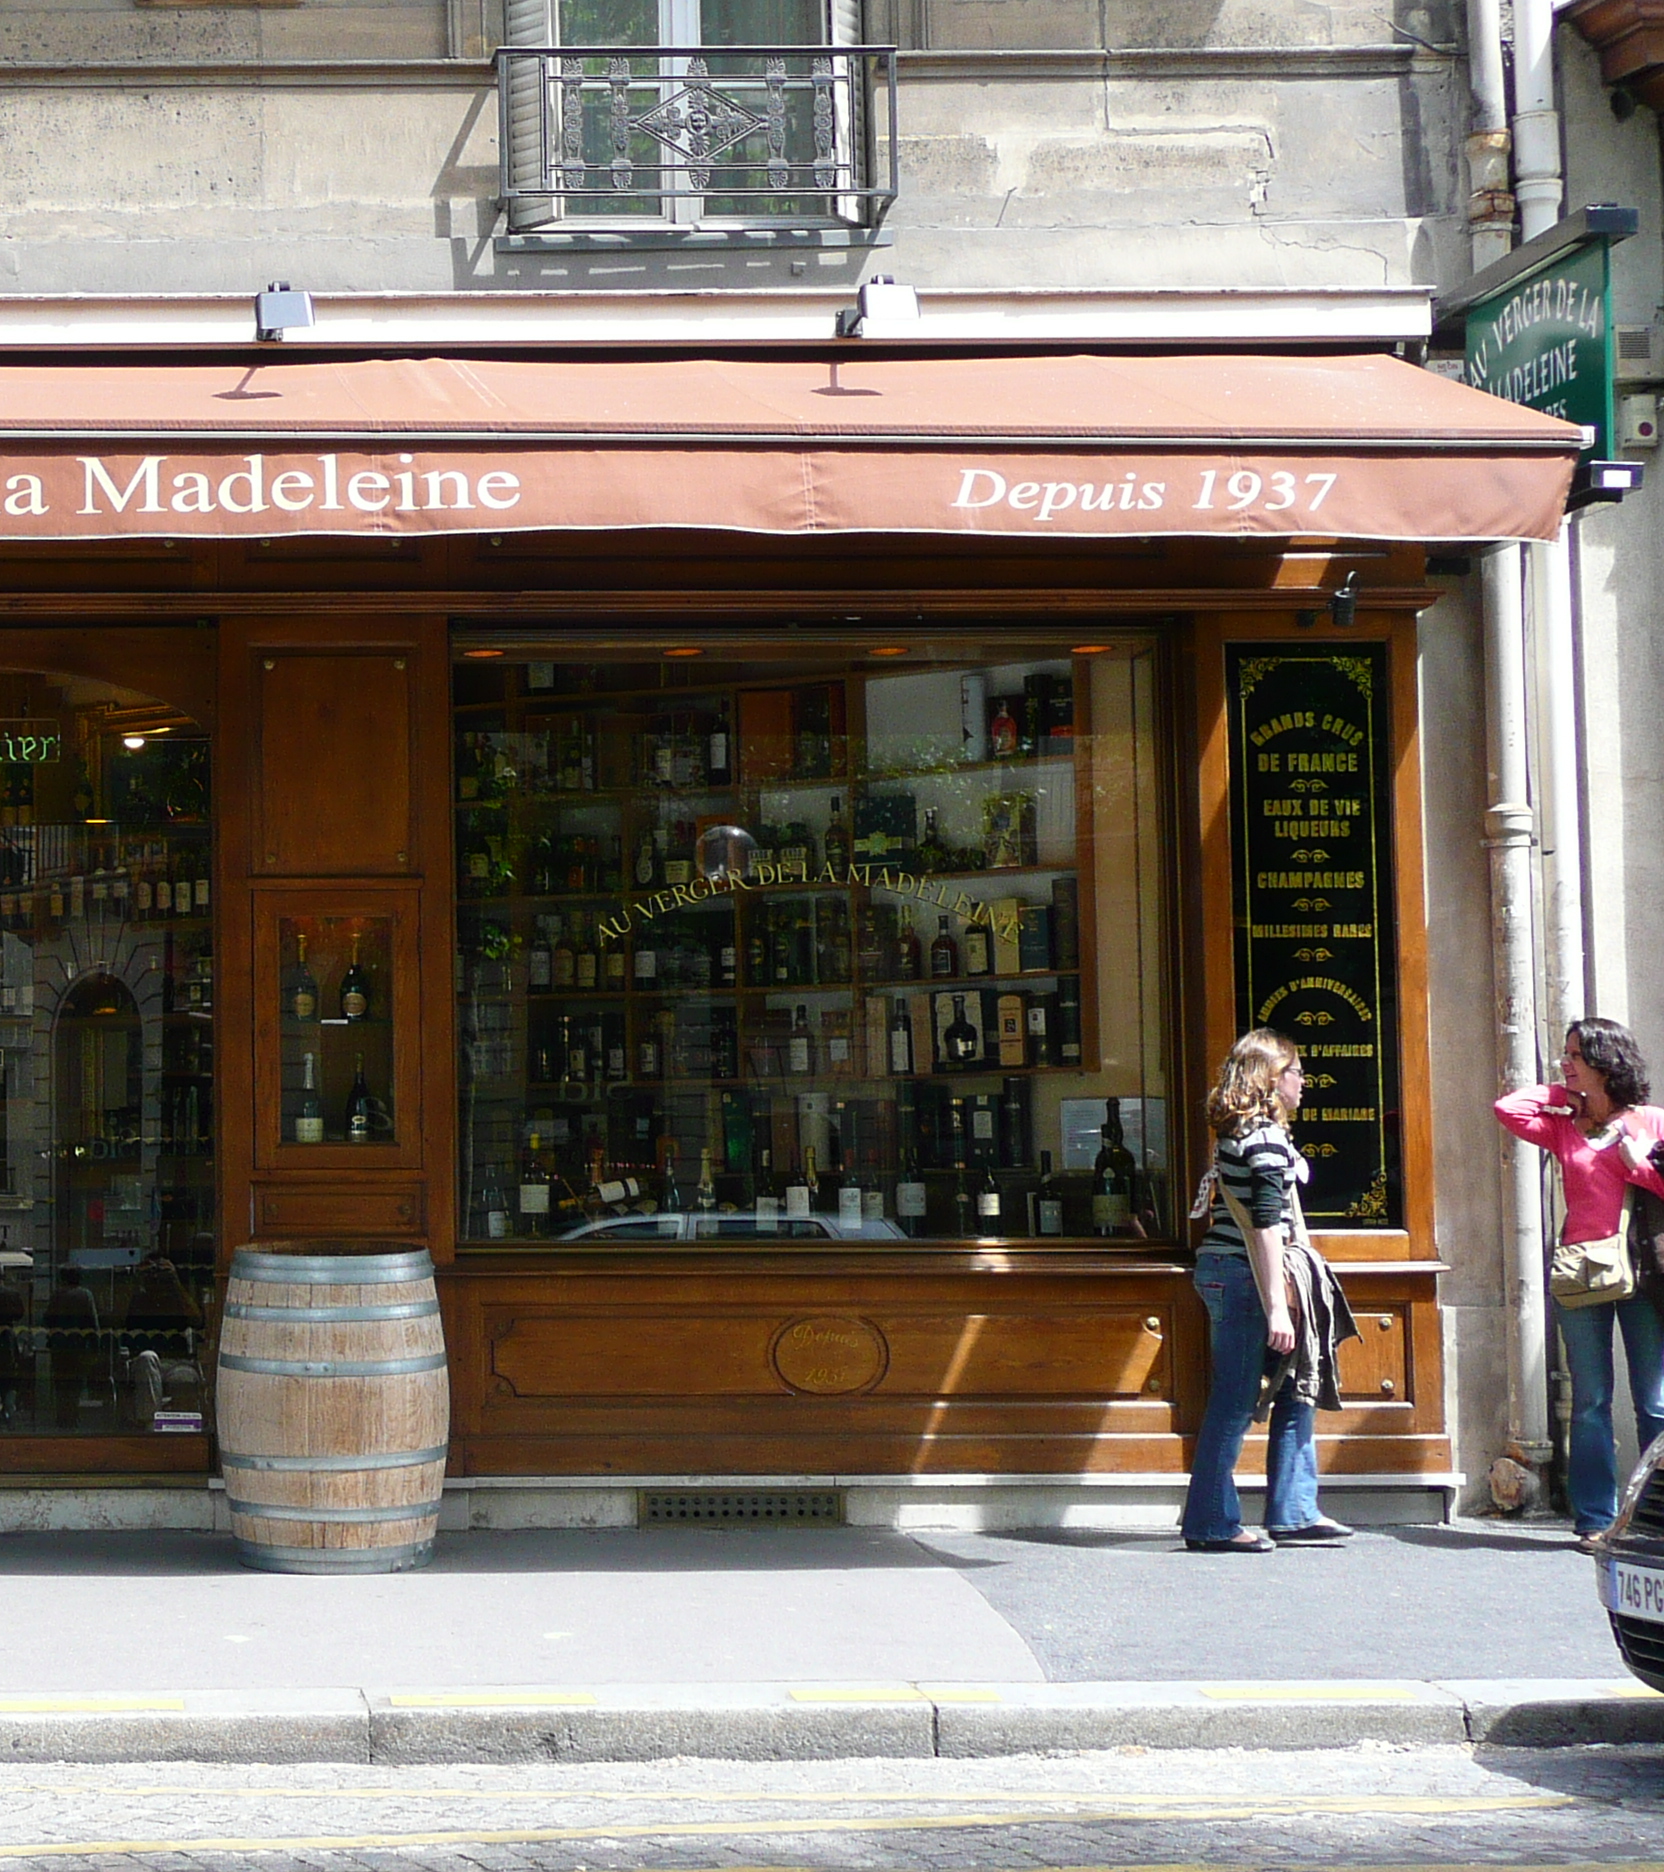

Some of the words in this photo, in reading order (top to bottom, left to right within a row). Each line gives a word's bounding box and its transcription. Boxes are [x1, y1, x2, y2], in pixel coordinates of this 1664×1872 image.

[1469, 339, 1487, 388] AU
[1492, 279, 1552, 352] VERGER
[1556, 278, 1579, 322] DE
[1578, 288, 1600, 338] LA
[75, 452, 522, 514] Madeleine
[950, 468, 1167, 522] Depuis
[1191, 469, 1338, 512] 1937
[1249, 710, 1315, 747] GRANDS
[1321, 713, 1365, 747] CRUS
[1257, 753, 1280, 772] DE
[1287, 753, 1359, 772] FRANCE
[1263, 799, 1303, 816] EAUX
[1309, 799, 1329, 816] DE
[1334, 799, 1361, 816] VIE
[1274, 820, 1351, 841] LIQUEURS
[1256, 871, 1366, 889] CHAMPAGNES
[597, 910, 633, 947] AU
[633, 869, 753, 920] VERGER
[757, 862, 795, 886] DE
[800, 860, 836, 884] LA
[845, 862, 1025, 945] MADELEINE
[1251, 924, 1329, 938] MILLESIMES
[1332, 923, 1373, 938] RARES
[1310, 1043, 1374, 1058] D'AFFAIRES
[1302, 1107, 1318, 1122] DE
[1617, 1570, 1642, 1609] 746
[1643, 1576, 1664, 1613] PG
